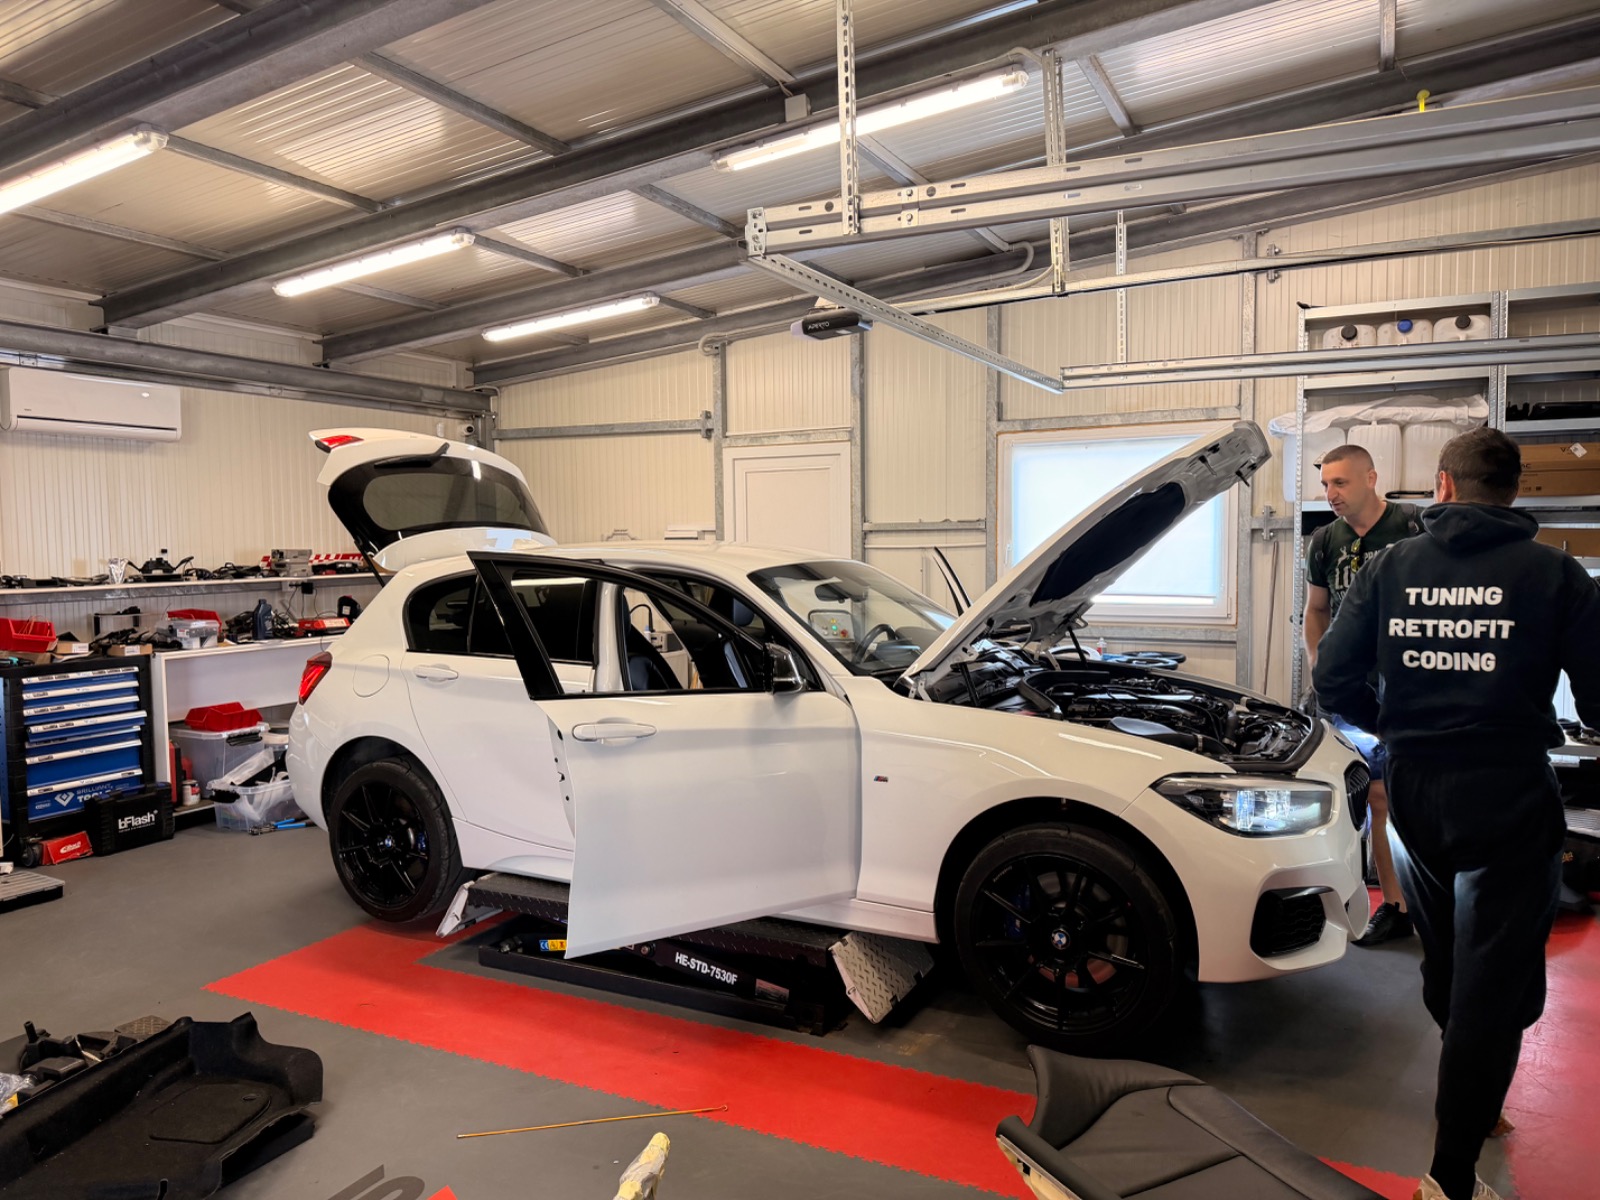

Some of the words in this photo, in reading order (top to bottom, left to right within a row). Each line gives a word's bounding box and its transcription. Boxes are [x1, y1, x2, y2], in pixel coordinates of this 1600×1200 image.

[1405, 586, 1503, 606] TUNING
[1388, 618, 1515, 639] RETROFIT
[1402, 650, 1496, 672] CODING
[118, 811, 156, 830] bFlash
[675, 951, 739, 986] HE-STD-7530F
